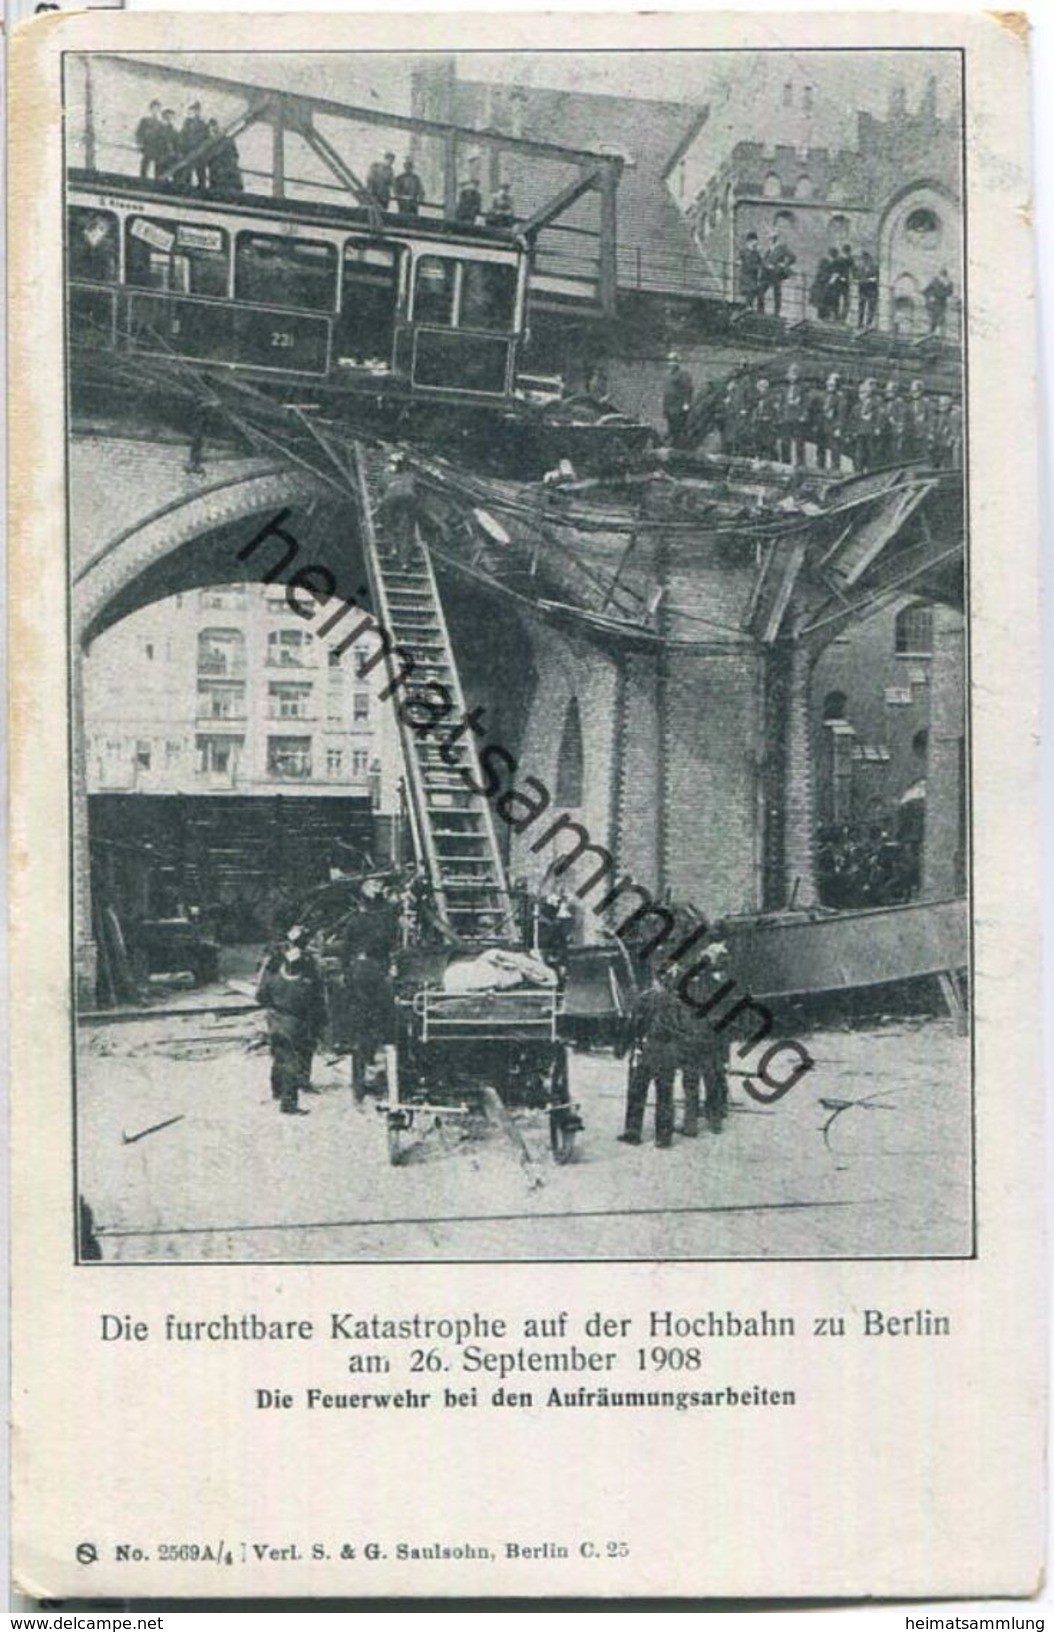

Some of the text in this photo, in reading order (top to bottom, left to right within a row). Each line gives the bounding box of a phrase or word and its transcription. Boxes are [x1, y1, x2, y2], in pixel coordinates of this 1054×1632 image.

[101, 1309, 951, 1344] Die furchtbare Katastrophe auf der Hochbahn zu Berlin
[348, 1345, 702, 1378] am 26. September 1908
[256, 1385, 796, 1411] Die Feuerwehr bei den Aufräumungsarbeiten
[115, 1544, 150, 1562] No.
[252, 1543, 302, 1561] Verl.
[312, 1543, 331, 1561] S.
[339, 1543, 356, 1560] &
[363, 1543, 388, 1561] G.
[396, 1542, 496, 1562] Saulsohn,
[506, 1542, 569, 1559] Berlin
[579, 1542, 600, 1559] C.
[606, 1542, 630, 1558] 25
